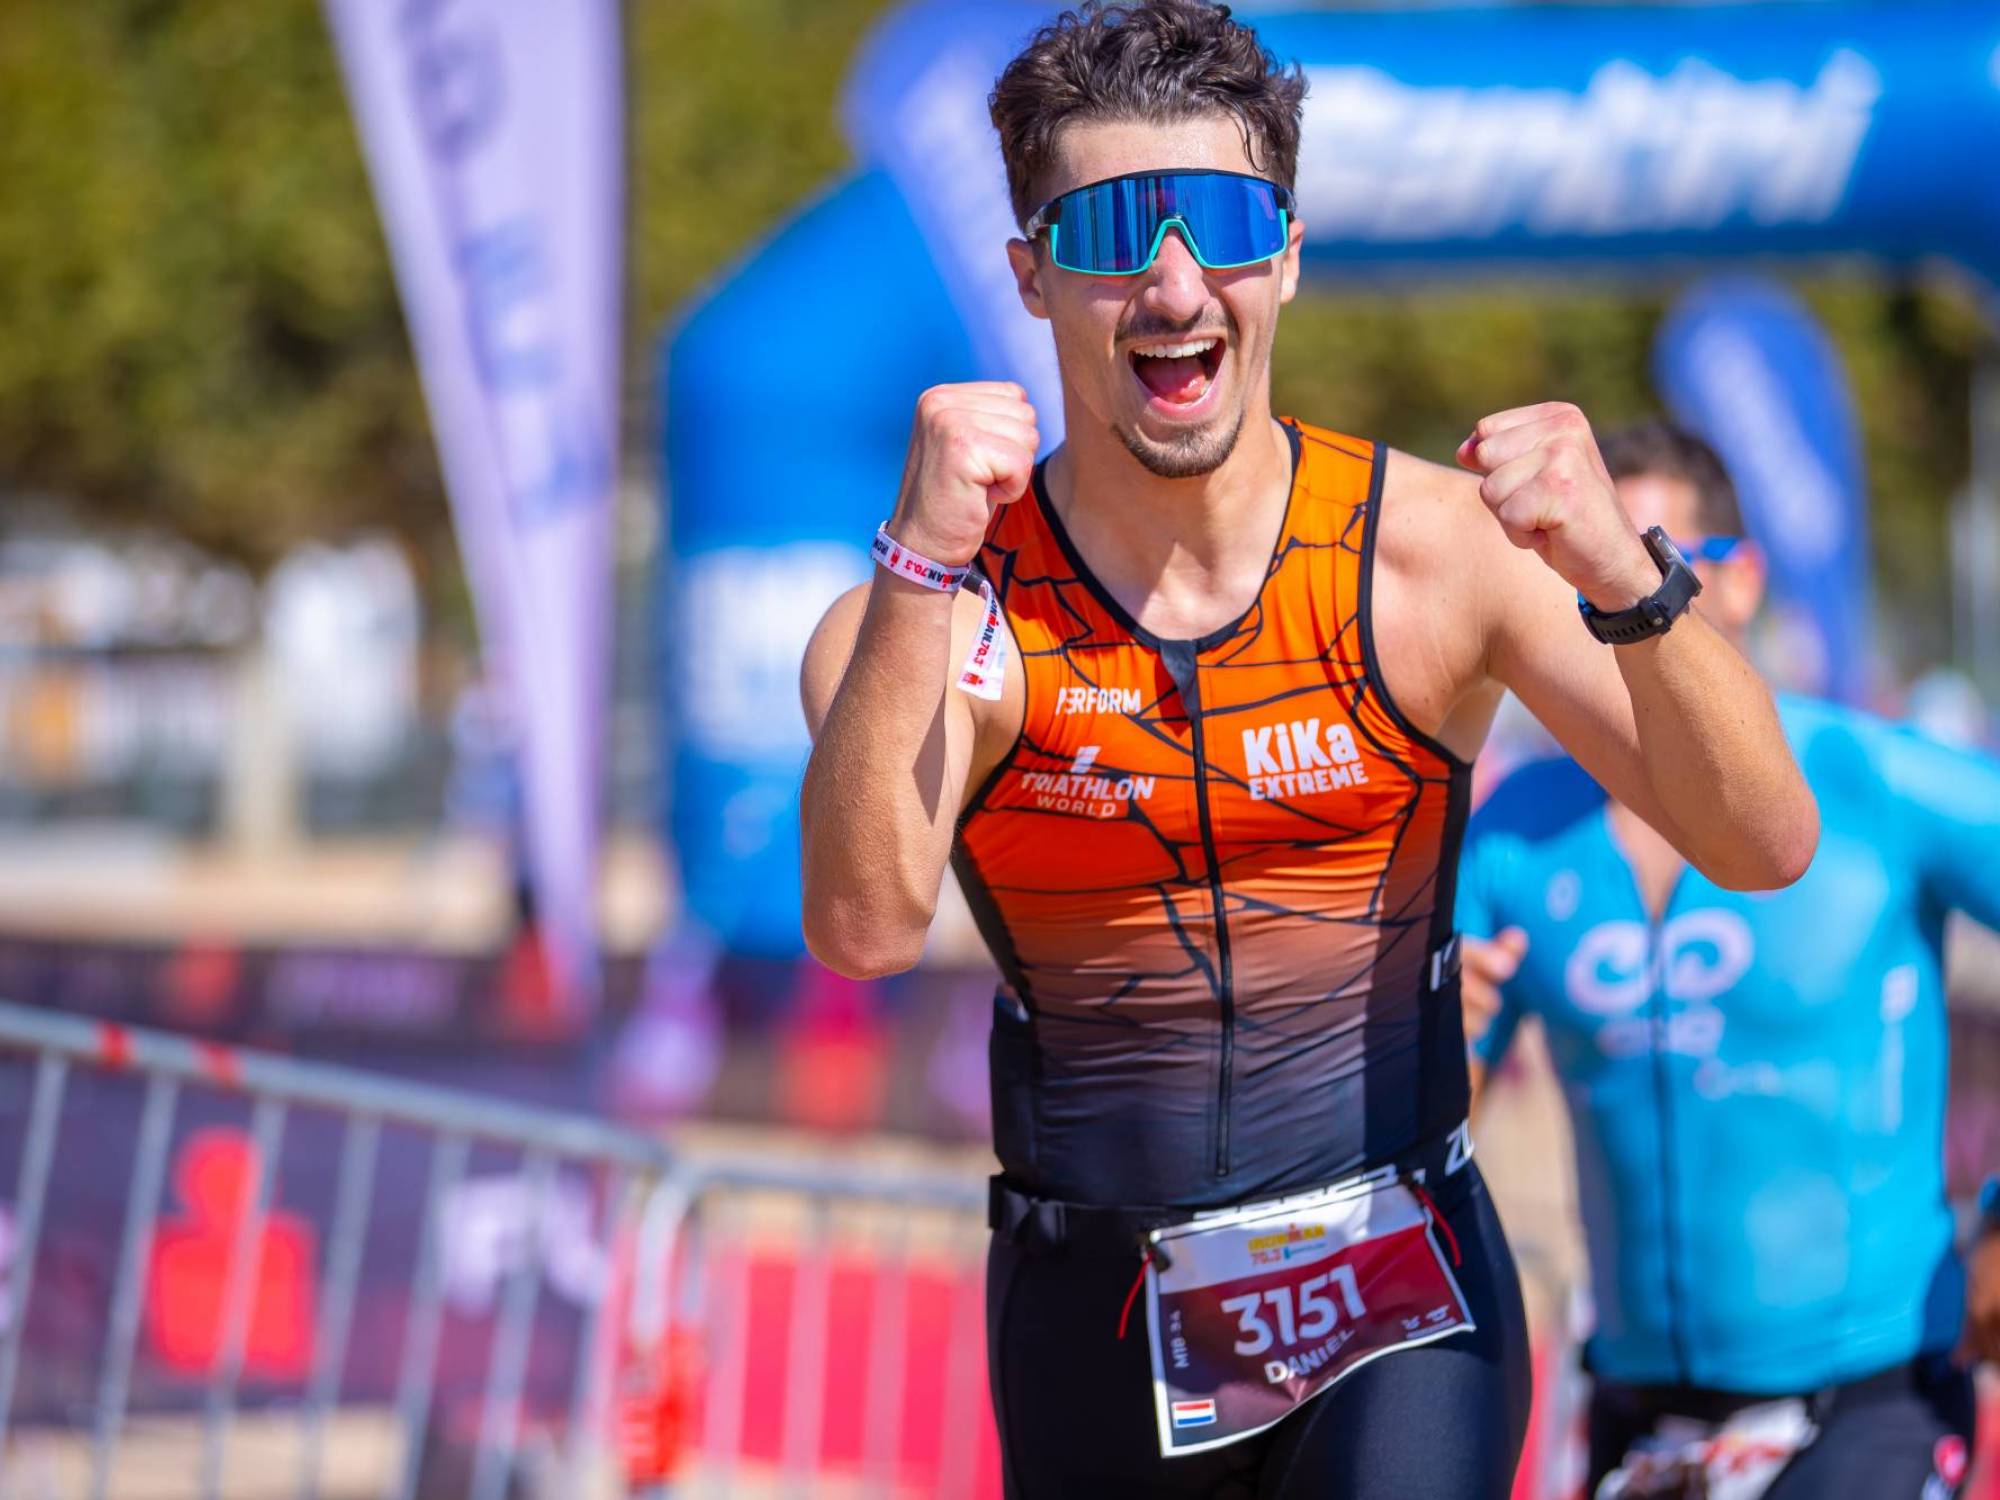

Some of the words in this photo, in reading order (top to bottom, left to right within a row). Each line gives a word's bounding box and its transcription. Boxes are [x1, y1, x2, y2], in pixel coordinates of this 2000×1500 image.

[1021, 771, 1156, 801] TRIATHLON
[1248, 761, 1370, 801] EXTREME
[1036, 793, 1118, 818] WORLD
[1220, 1263, 1367, 1356] 3151
[1263, 1328, 1357, 1384] DANIEL
